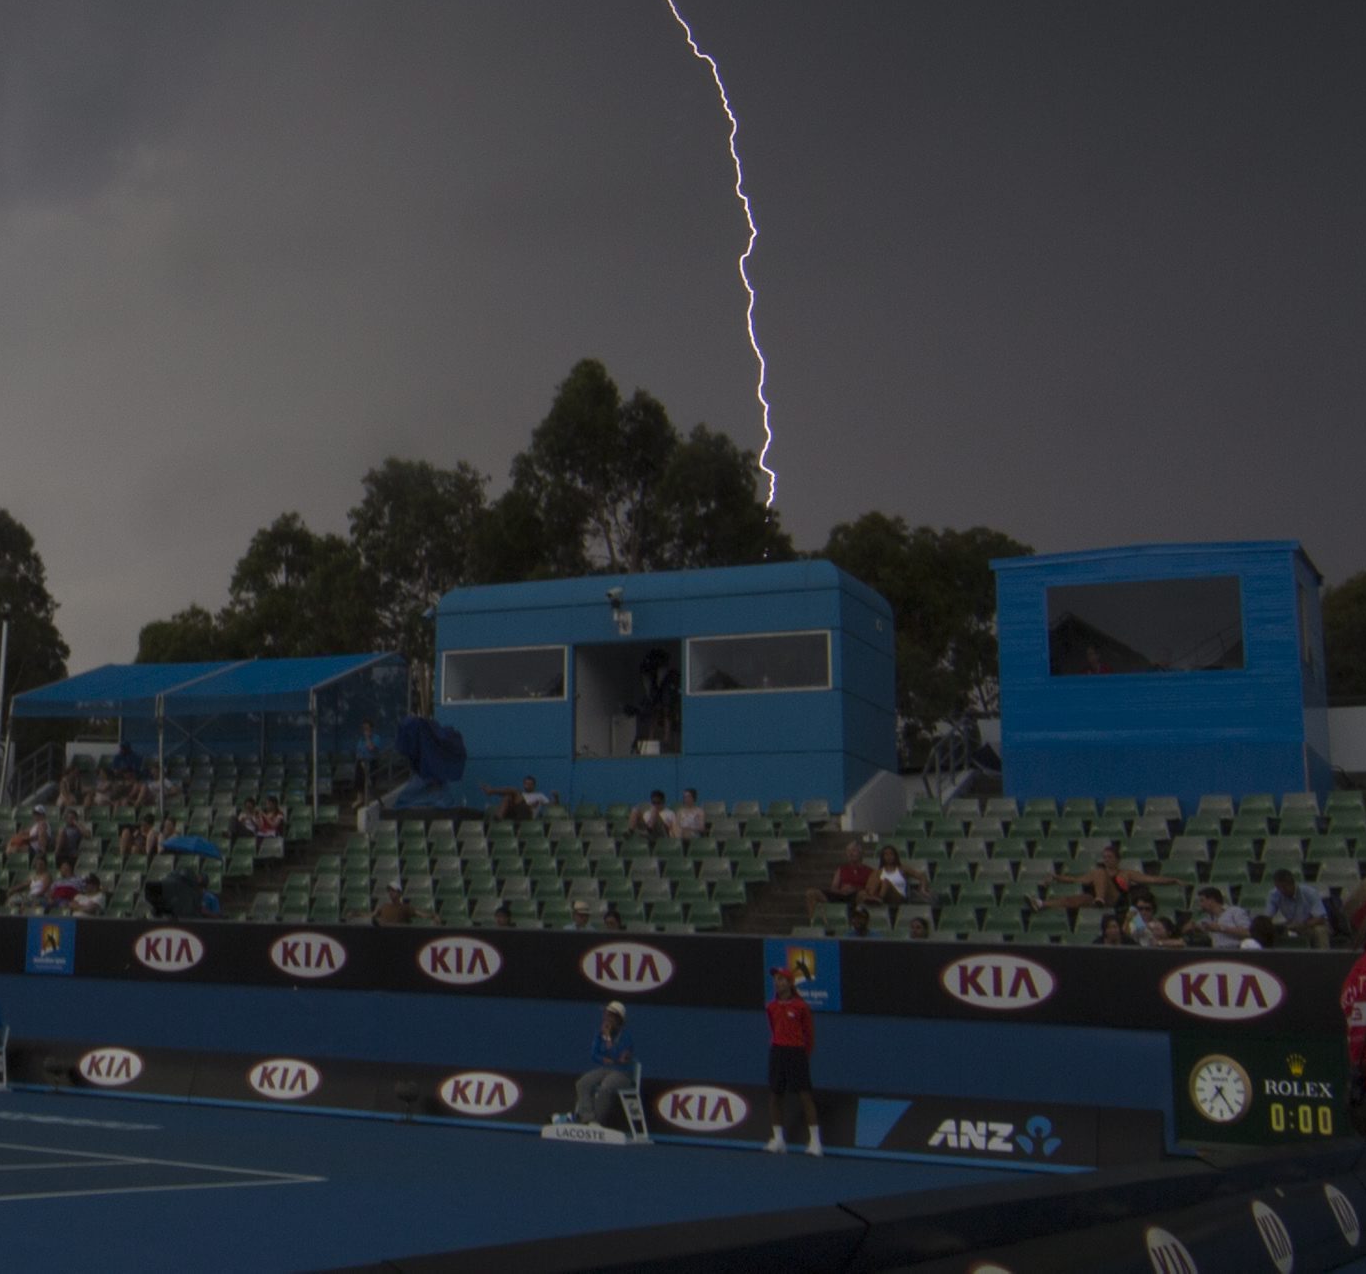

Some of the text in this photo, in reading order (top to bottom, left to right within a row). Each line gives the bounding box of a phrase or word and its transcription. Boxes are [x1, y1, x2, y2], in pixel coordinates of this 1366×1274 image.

[144, 937, 194, 964] KIA
[282, 941, 336, 970] KIA
[431, 945, 491, 976] KIA
[595, 952, 661, 984] KIA
[958, 964, 1040, 1000] KIA
[1180, 972, 1268, 1009] KIA
[87, 1054, 132, 1079] KIA
[258, 1066, 308, 1093] KIA
[450, 1079, 507, 1108] KIA
[1264, 1078, 1334, 1099] ROLEX
[669, 1092, 734, 1123] KIA
[1270, 1101, 1333, 1136] 0:00
[555, 1127, 606, 1141] LACOSTE
[927, 1118, 1014, 1153] ANZ
